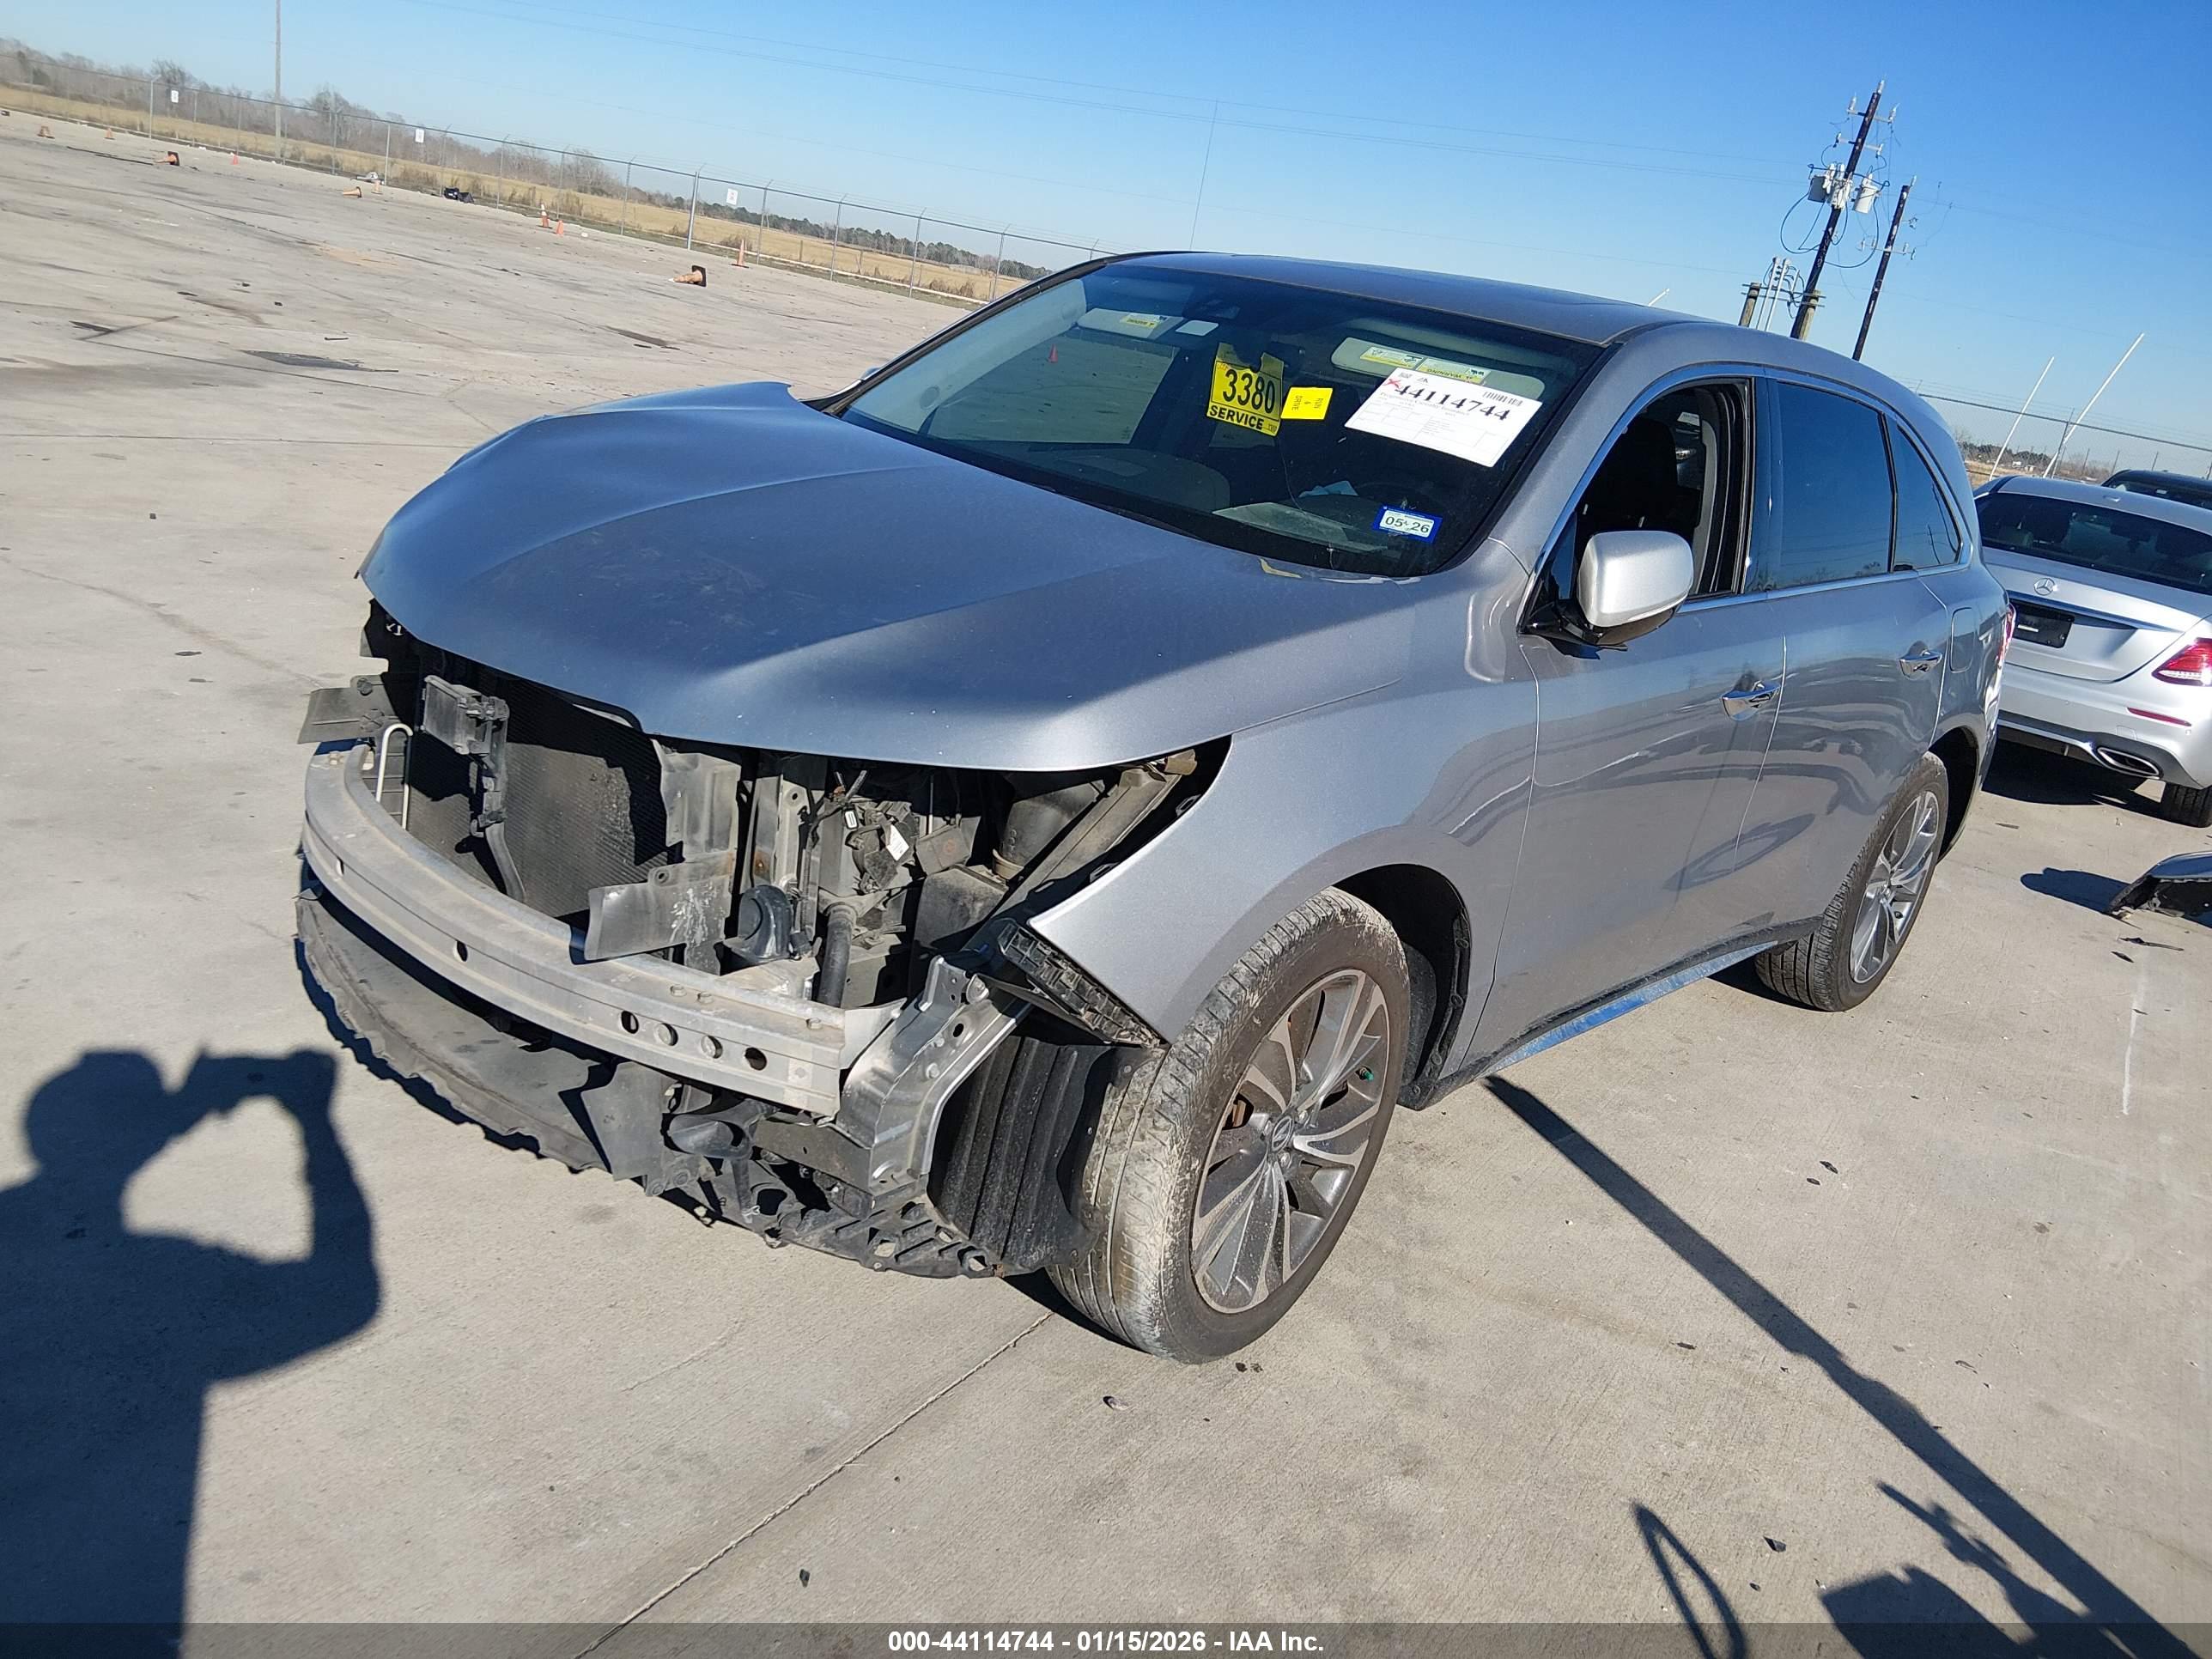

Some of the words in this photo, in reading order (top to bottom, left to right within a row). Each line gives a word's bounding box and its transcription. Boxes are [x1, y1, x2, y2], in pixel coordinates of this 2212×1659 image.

[1222, 368, 1275, 414] 3380
[1395, 385, 1511, 421] 44114744
[1209, 404, 1265, 430] SERVICE
[1385, 516, 1404, 527] 05
[1410, 521, 1431, 533] 26
